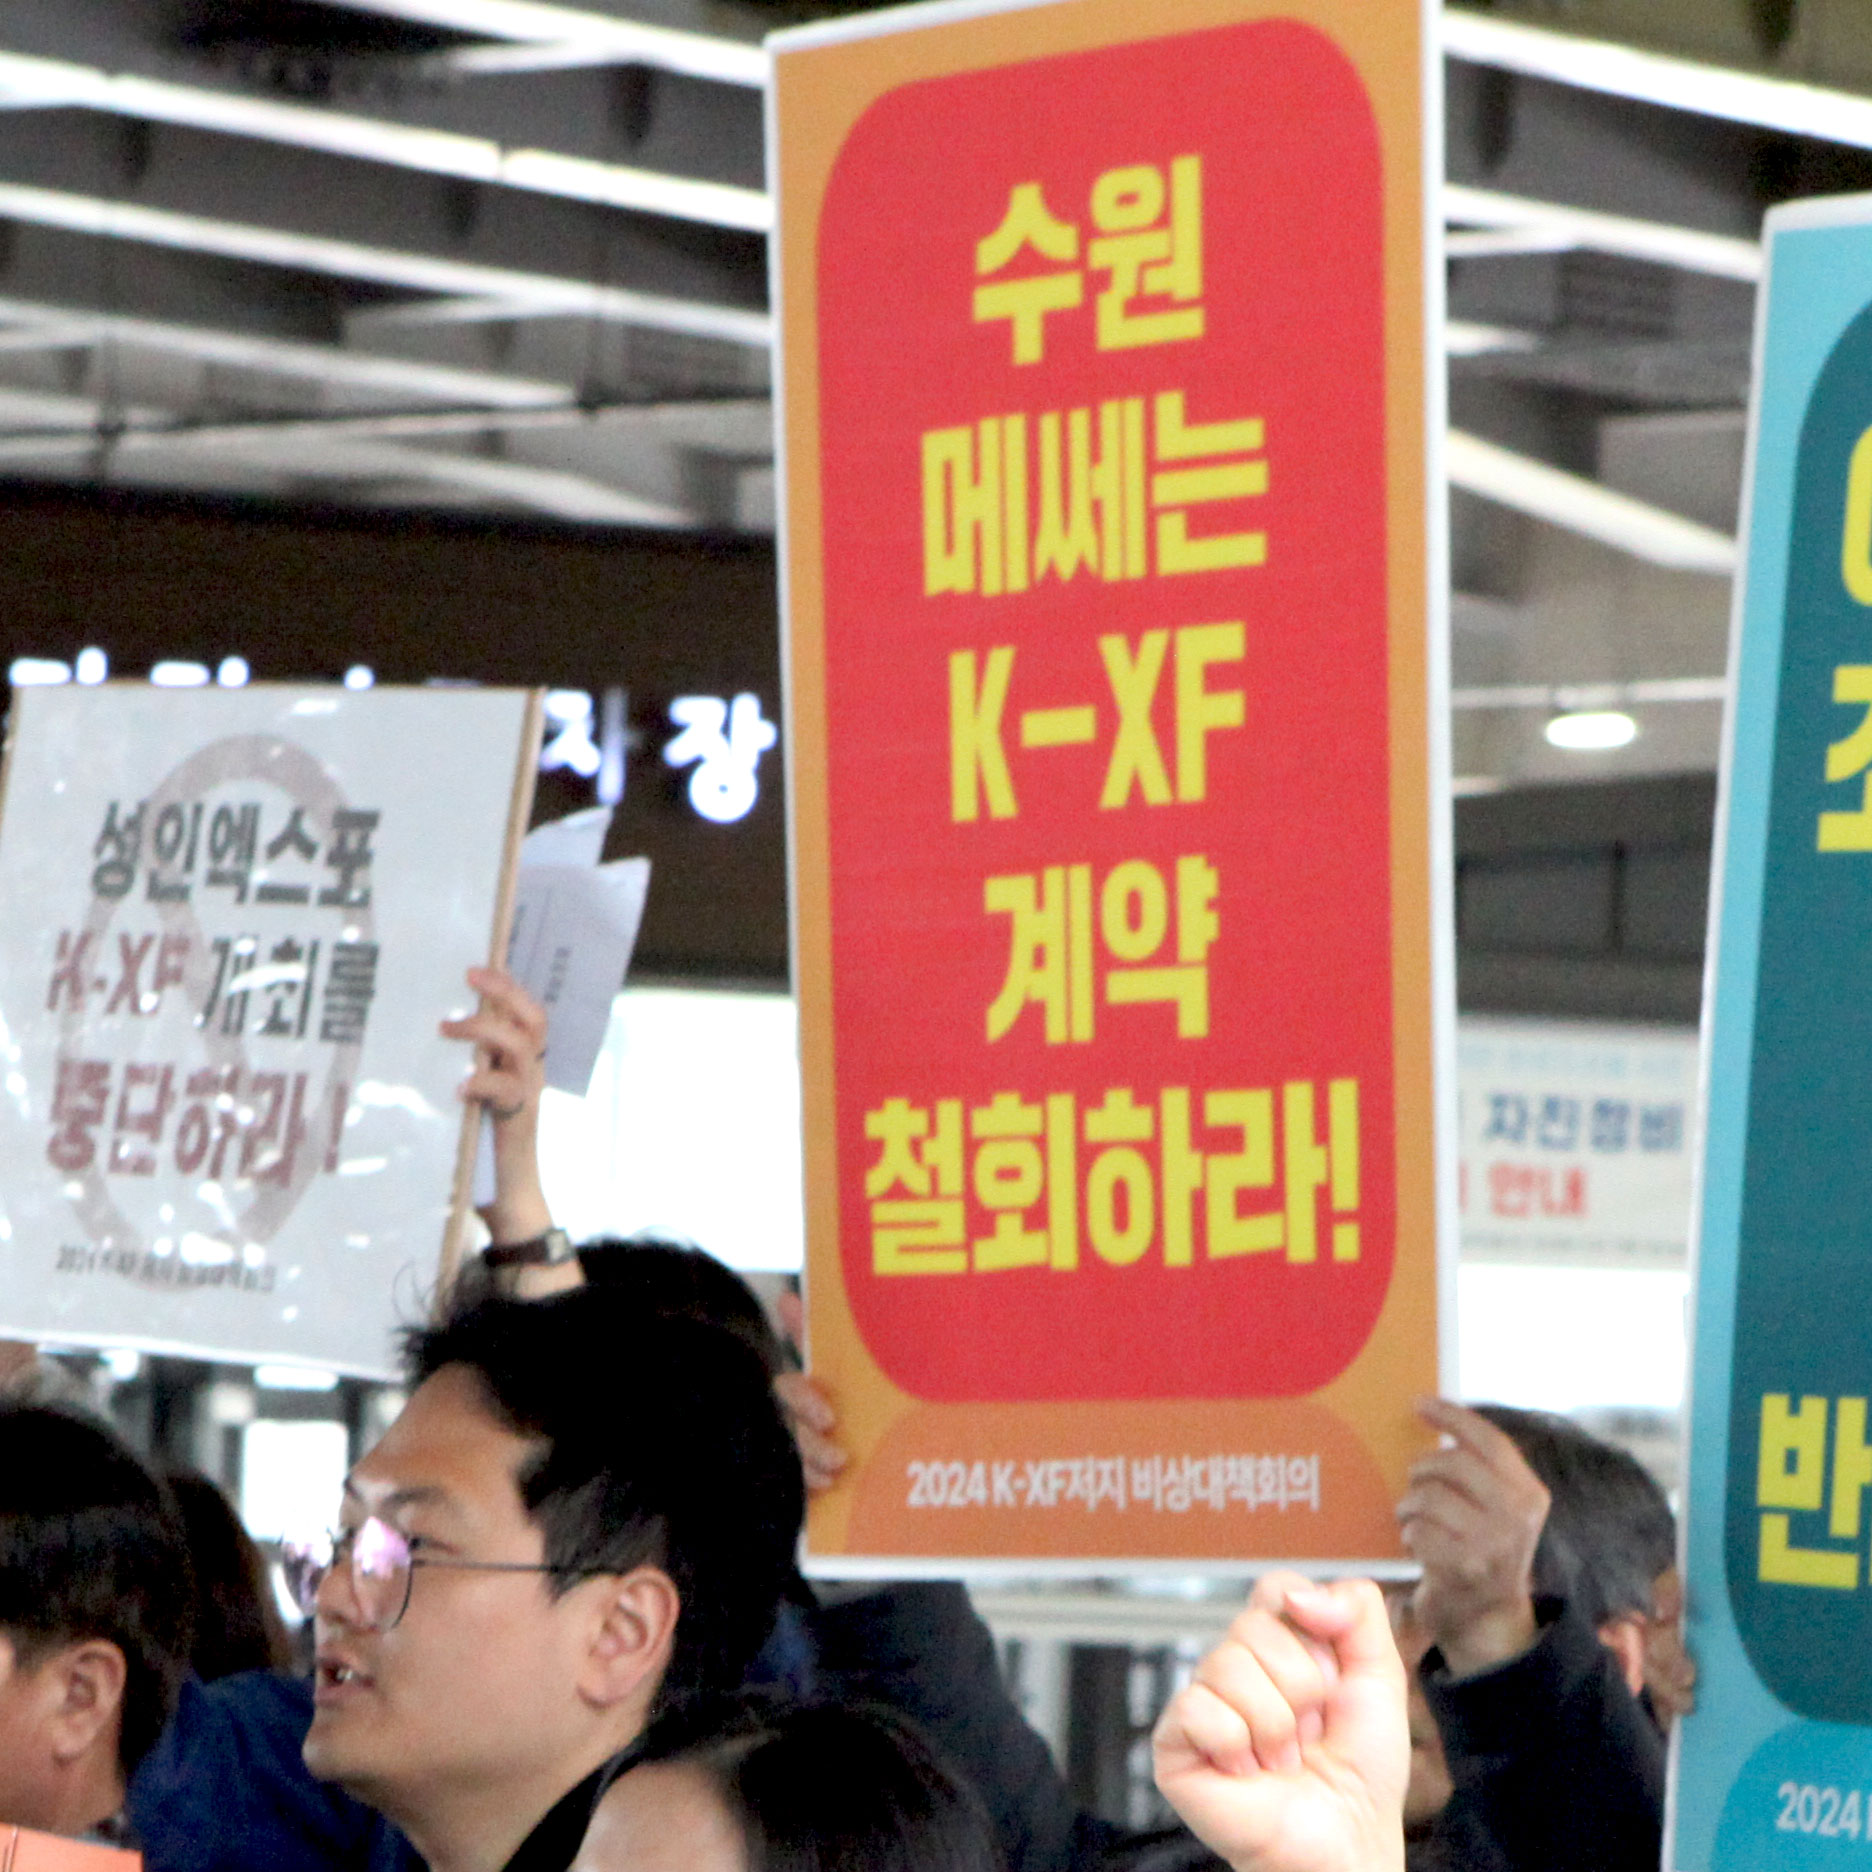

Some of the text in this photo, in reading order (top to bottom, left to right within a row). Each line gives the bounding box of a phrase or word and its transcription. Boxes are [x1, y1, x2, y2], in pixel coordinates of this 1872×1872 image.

[972, 154, 1205, 367] 수원
[921, 389, 1269, 599] 메쎄는
[948, 620, 1247, 824] K-XF
[92, 800, 381, 907] 성인엑스포
[47, 931, 380, 1043] K-XF 개최를
[984, 855, 1220, 1045] 계약
[864, 1077, 1361, 1276] 철회하라!
[906, 1459, 986, 1508] 2024
[1131, 1453, 1320, 1513] 비상대책회의
[1776, 1780, 1862, 1840] 2024
